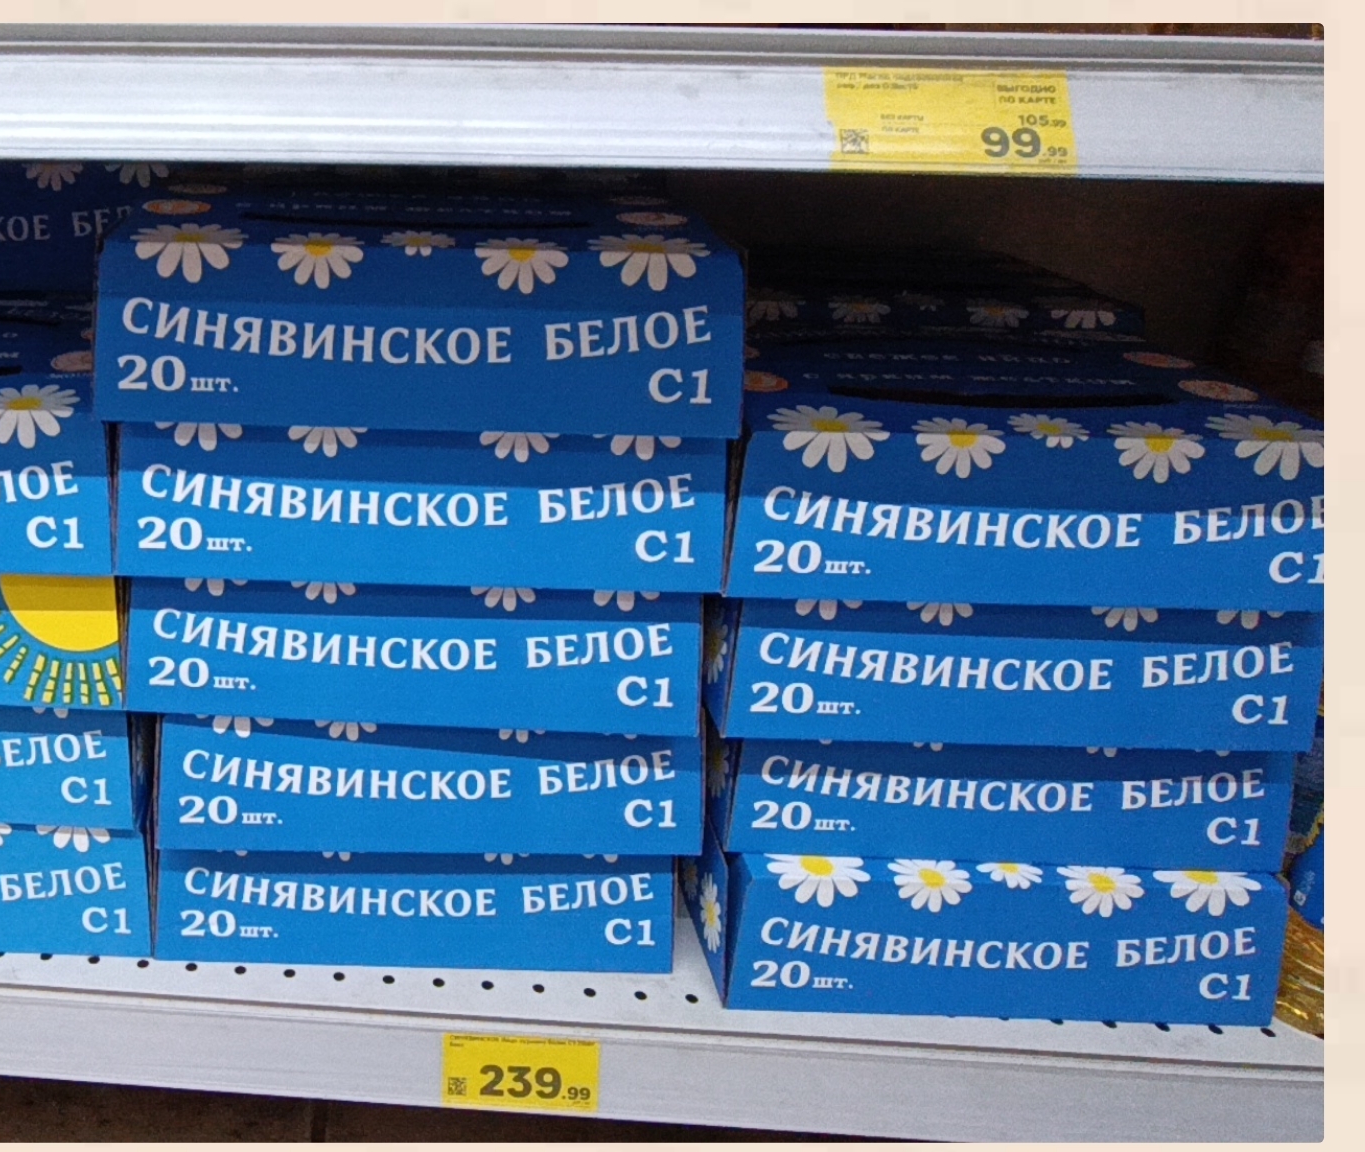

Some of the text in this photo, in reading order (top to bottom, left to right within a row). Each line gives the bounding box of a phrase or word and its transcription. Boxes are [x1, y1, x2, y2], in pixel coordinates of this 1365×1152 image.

[122, 297, 712, 366] СИНЯВИНСКОЕ БЕЛОЕ
[141, 463, 695, 528] СИНЯВИНСКОЕ БЕЛОЕ
[763, 485, 1143, 550] СИНЯВИНСКОЕ
[152, 607, 674, 671] СИНЯВИНСКОЕ БЕЛОЕ
[758, 631, 1295, 692] СИНЯВИНСКОЕ БЕЛОЕ
[181, 748, 677, 801] СИНЯВИНСКОЕ БЕЛОЕ
[760, 754, 1266, 813] СИНЯВИНСКОЕ БЕЛОЕ
[183, 866, 655, 919] СИНЯВИНСКОЕ БЕЛОЕ
[759, 916, 1257, 971] СИНЯВИНСКОЕ БЕЛОЕ
